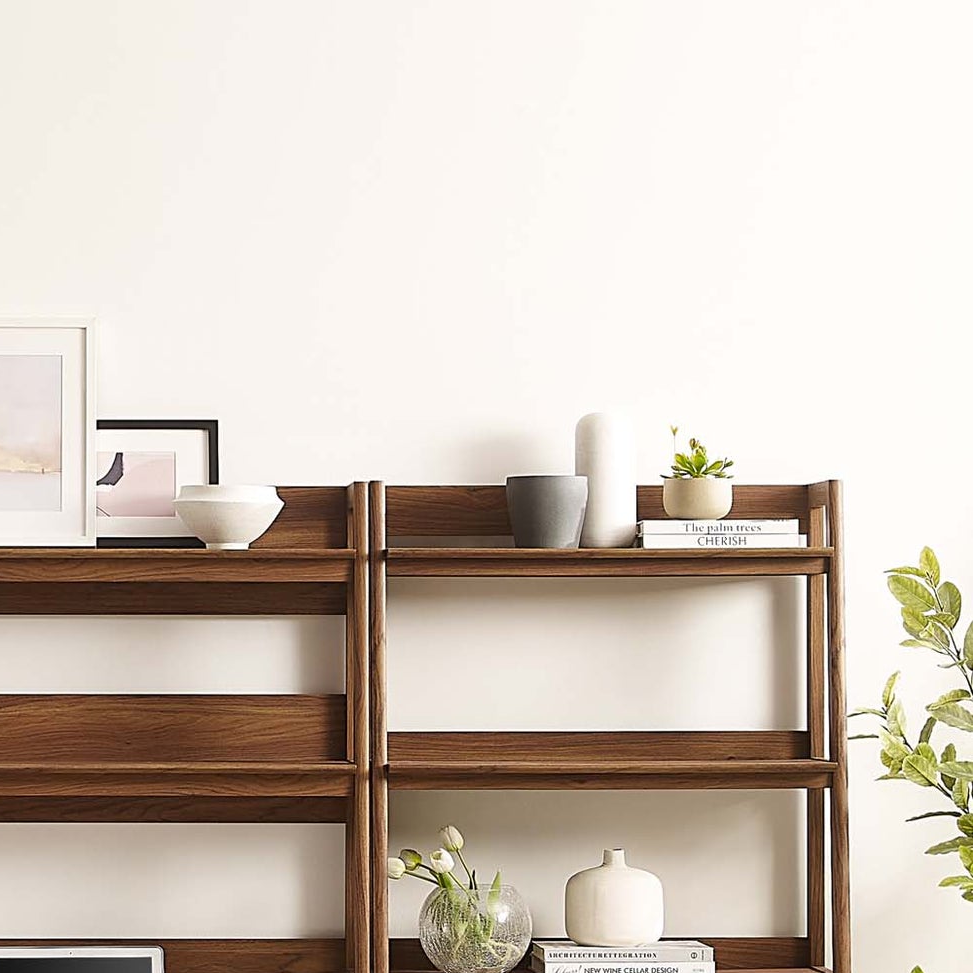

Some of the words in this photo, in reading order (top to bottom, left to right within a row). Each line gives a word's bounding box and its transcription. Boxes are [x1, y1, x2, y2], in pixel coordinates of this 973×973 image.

[683, 523, 704, 532] The
[707, 523, 733, 534] palm
[736, 523, 762, 532] trees
[697, 536, 747, 546] CHERISH
